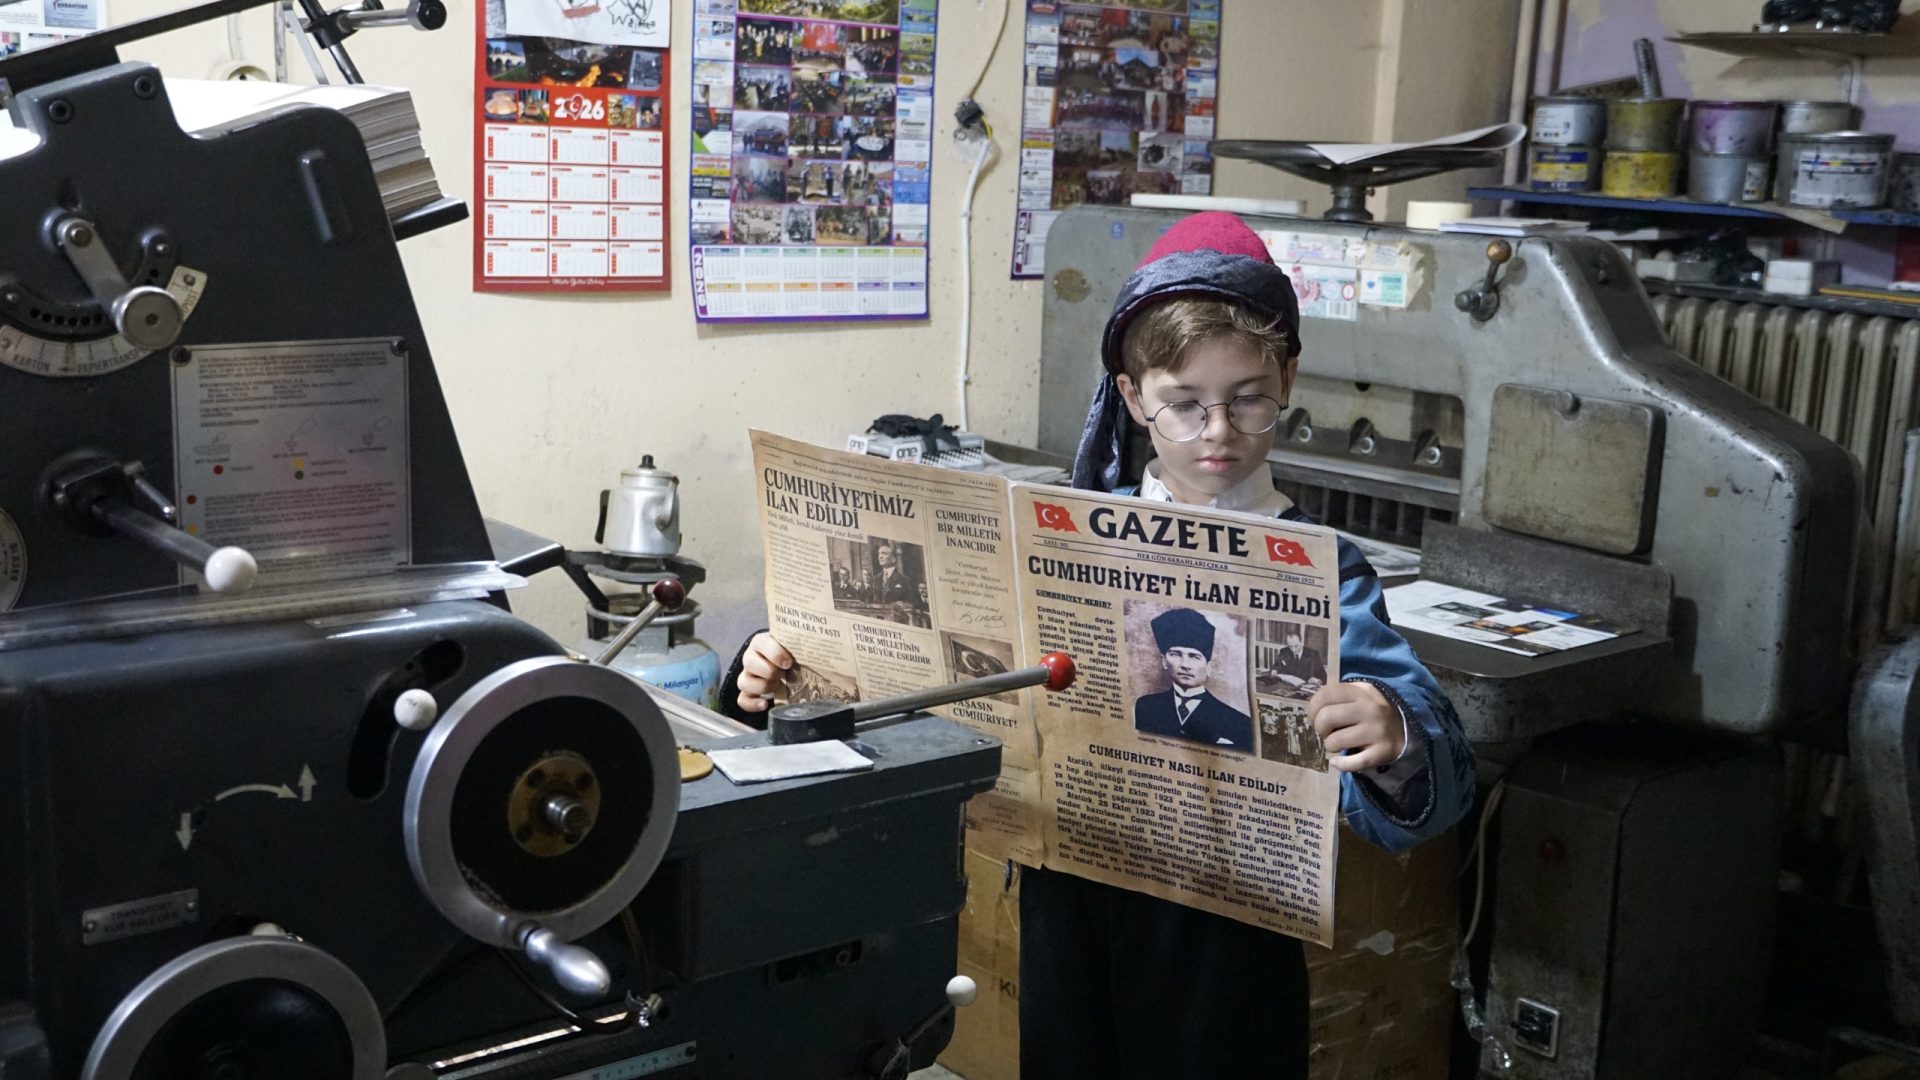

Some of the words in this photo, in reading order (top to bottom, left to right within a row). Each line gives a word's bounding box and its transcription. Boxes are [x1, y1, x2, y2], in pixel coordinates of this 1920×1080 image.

[694, 253, 706, 306] 2026
[12, 354, 50, 372] KARTON
[896, 446, 918, 458] one
[764, 467, 915, 519] CUMHURİYETİMİZ
[766, 486, 798, 515] İLAN
[806, 501, 860, 529] EDİLDİ
[936, 510, 999, 528] CUMHURİYET
[938, 522, 954, 534] BİR
[956, 524, 1001, 541] MİLLETİN
[1088, 507, 1249, 558] GAZETE
[946, 535, 996, 554] İNANCIDIR
[1137, 552, 1150, 560] HER
[1151, 554, 1166, 562] GÜN
[1167, 556, 1206, 568] SABAHLARI
[1207, 561, 1228, 570] ÇIKAR
[1028, 555, 1176, 597] CUMHURİYET
[1185, 574, 1240, 606] İLAN
[1249, 588, 1330, 619] EDİLDİ
[1036, 589, 1082, 603] CUMHURİYET
[775, 604, 799, 618] HALKIN
[800, 610, 827, 625] SEVİNCİ
[775, 616, 816, 633] SOKAKLARA
[820, 626, 841, 639] TAŞTI
[854, 633, 875, 644] TÜRK
[877, 636, 920, 653] MİLLETİNİN
[868, 644, 895, 658] BÜYÜK
[896, 650, 931, 665] ESERİDİR
[664, 678, 698, 689] Milangaz
[953, 707, 1017, 728] CUMHURİYET!
[1089, 744, 1165, 768] CUMHURİYET
[1169, 760, 1203, 777] NASIL
[1208, 767, 1235, 784] İLAN
[1239, 776, 1287, 796] EDİLDİ?
[1100, 763, 1122, 774] ülkeyi
[1127, 769, 1171, 785] düşmandan
[1217, 788, 1246, 800] sınırları
[1252, 796, 1302, 813] belirledikten
[1306, 810, 1323, 819] son-
[1066, 764, 1079, 774] hep
[1084, 768, 1125, 785] düşündüğü
[1131, 779, 1181, 796] cumhuriyetin
[1187, 791, 1203, 801] ilanı
[1210, 796, 1242, 810] üzerinde
[1249, 805, 1288, 820] hazırlıklar
[1294, 816, 1322, 830] yapma-
[1068, 773, 1094, 786] başladı
[1113, 784, 1123, 792] 28
[1128, 787, 1148, 798] Ekim
[1154, 792, 1172, 803] 1923
[1179, 798, 1205, 812] akşamı
[1212, 807, 1232, 818] yakın
[1238, 812, 1290, 831] arkadaşlarını
[1296, 826, 1321, 839] Çanka-
[1079, 785, 1106, 799] yemeğe
[1182, 809, 1231, 828] Cumhuriyet'i
[1236, 822, 1251, 831] ilan
[1056, 797, 1080, 809] dından
[1086, 804, 1124, 820] hazırlanan
[1131, 814, 1173, 832] Cumhuriyet
[1179, 827, 1223, 844] önergesinin
[1230, 839, 1256, 852] taslağı
[1262, 846, 1292, 861] Türkiye
[1298, 855, 1320, 869] Büyük
[1057, 806, 1076, 817] Millet
[1150, 829, 1174, 841] Meclis
[1178, 836, 1210, 851] önergeyi
[1214, 845, 1235, 856] kabul
[1272, 859, 1298, 871] ülkede
[1302, 868, 1320, 879] cum-
[1098, 798, 1107, 807] 29
[1112, 802, 1130, 812] Ekim
[1136, 806, 1154, 817] 1923
[1184, 819, 1236, 837] milletvekilleri
[1254, 835, 1308, 855] görüşmesinin
[1079, 847, 1103, 859] dinden
[1275, 897, 1320, 916] bakılmaksı-
[1091, 832, 1119, 845] kurulan
[1123, 840, 1152, 854] Türkiye
[1221, 865, 1230, 874] ilk
[1236, 868, 1296, 891] Cumhurbaşkanı
[1153, 838, 1182, 852] Devletin
[1186, 847, 1198, 856] adı
[1201, 851, 1229, 865] Türkiye
[1233, 858, 1280, 877] Cumhuriyeti
[1306, 878, 1320, 888] Ata-
[1171, 861, 1199, 875] kayıtsız
[1204, 870, 1228, 883] şartsız
[1233, 877, 1263, 891] milletin
[1291, 892, 1303, 901] Her
[1308, 896, 1320, 906] dil-
[1283, 910, 1297, 921] eşit
